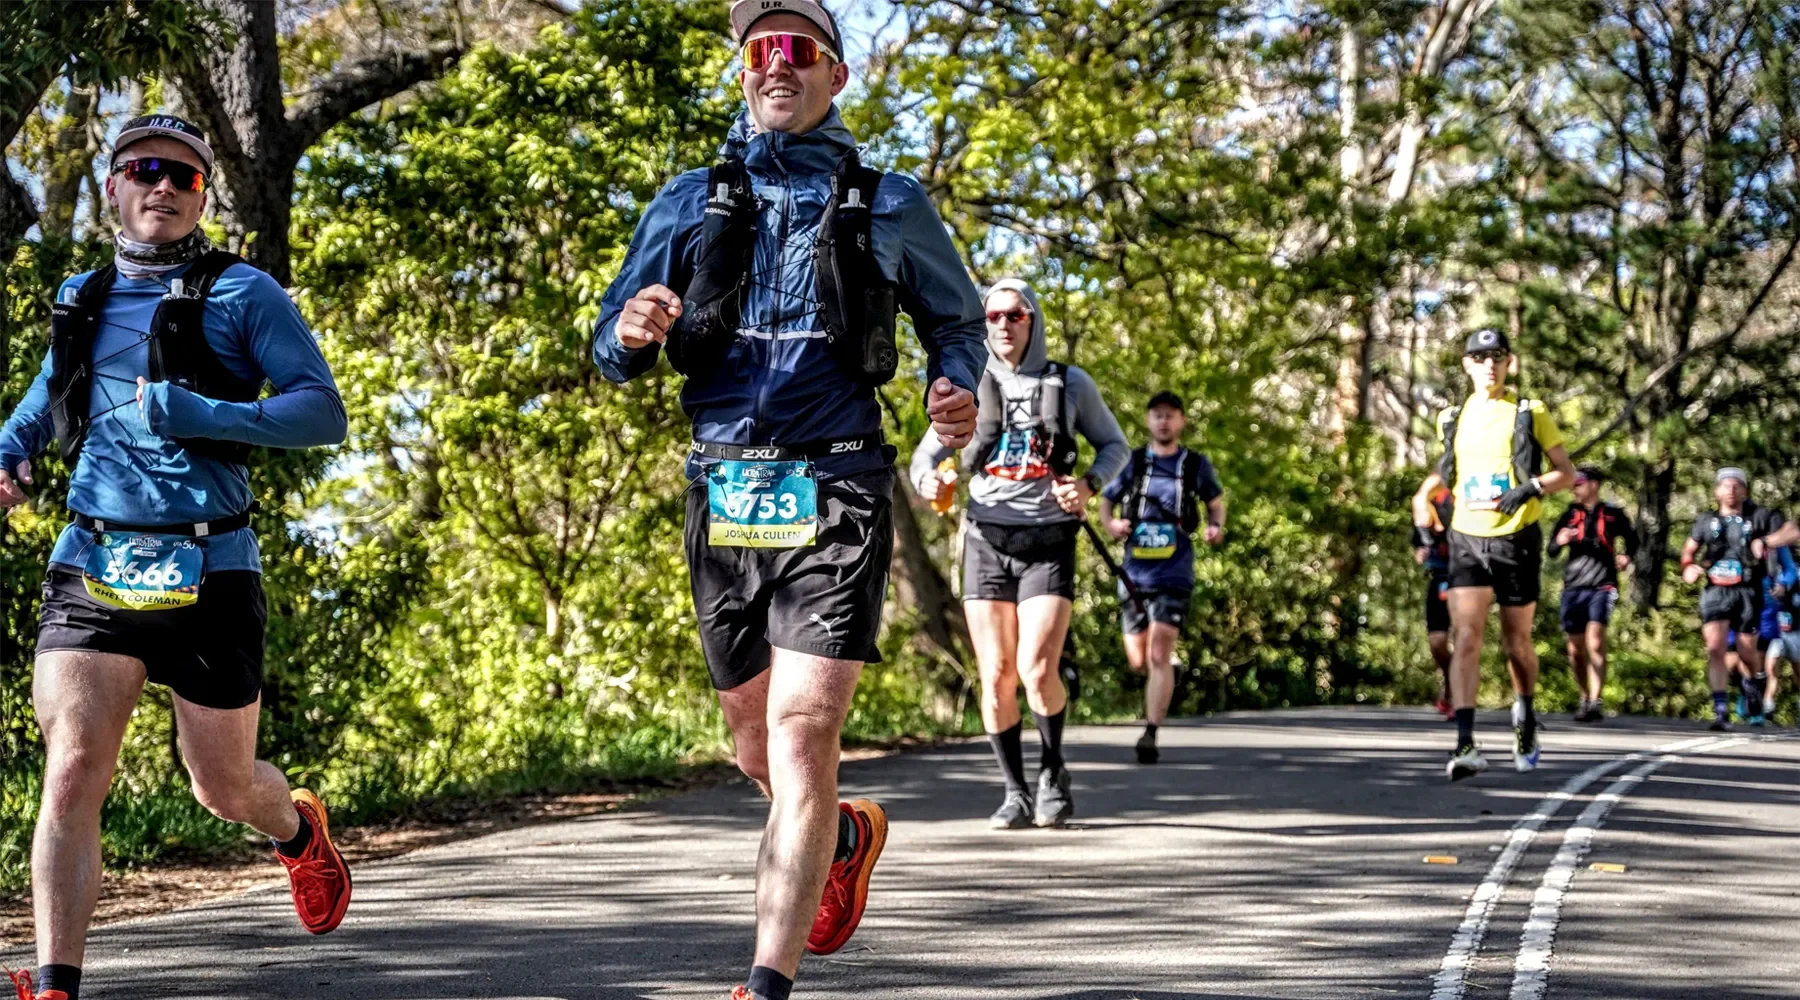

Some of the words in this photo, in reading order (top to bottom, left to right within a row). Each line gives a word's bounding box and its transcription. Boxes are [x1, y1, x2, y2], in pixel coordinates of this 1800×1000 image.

[692, 440, 706, 453] XU
[830, 440, 863, 453] 2XU
[741, 449, 779, 459] 2XU
[725, 492, 798, 519] 6753
[725, 530, 759, 539] JOSHUA
[101, 561, 183, 586] 5666
[94, 587, 125, 601] RHETT
[128, 594, 181, 606] COLEMAN
